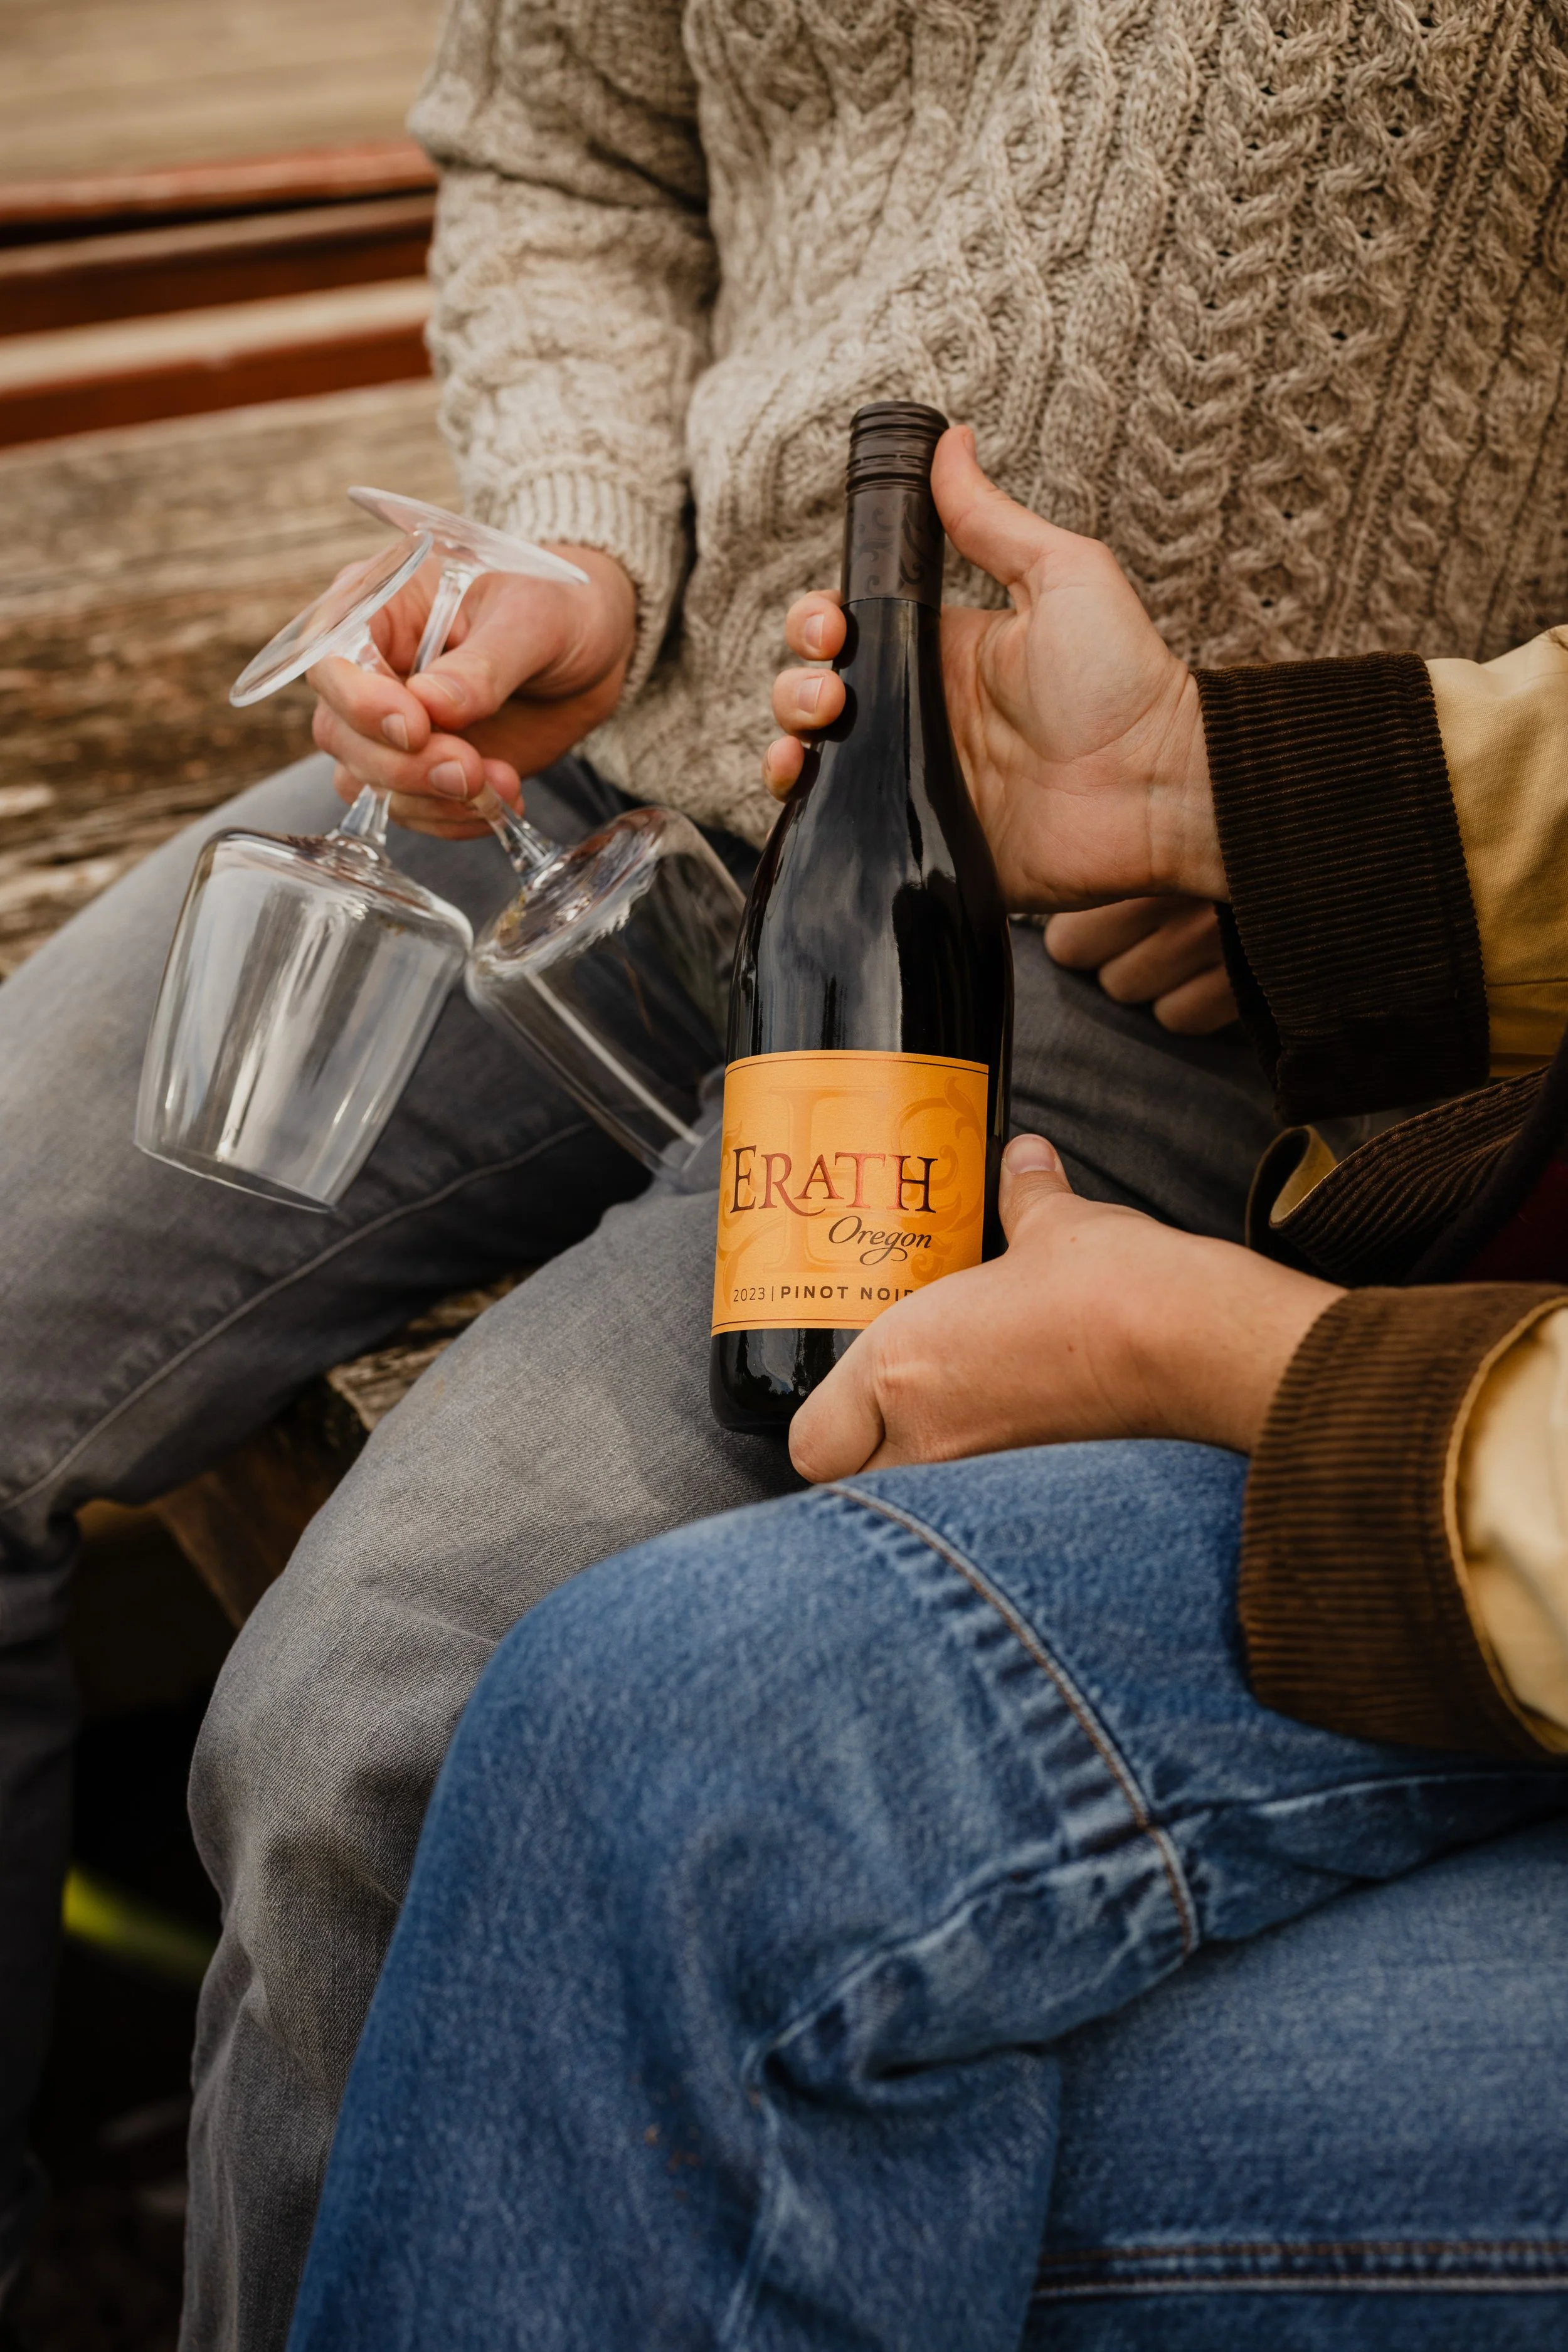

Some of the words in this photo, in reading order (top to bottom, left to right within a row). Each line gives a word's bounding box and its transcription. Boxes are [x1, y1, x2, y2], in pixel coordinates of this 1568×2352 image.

[730, 1145, 938, 1217] ERATH
[829, 1216, 931, 1266] Oregon
[733, 1287, 766, 1303] 2023
[780, 1285, 849, 1300] PINOT
